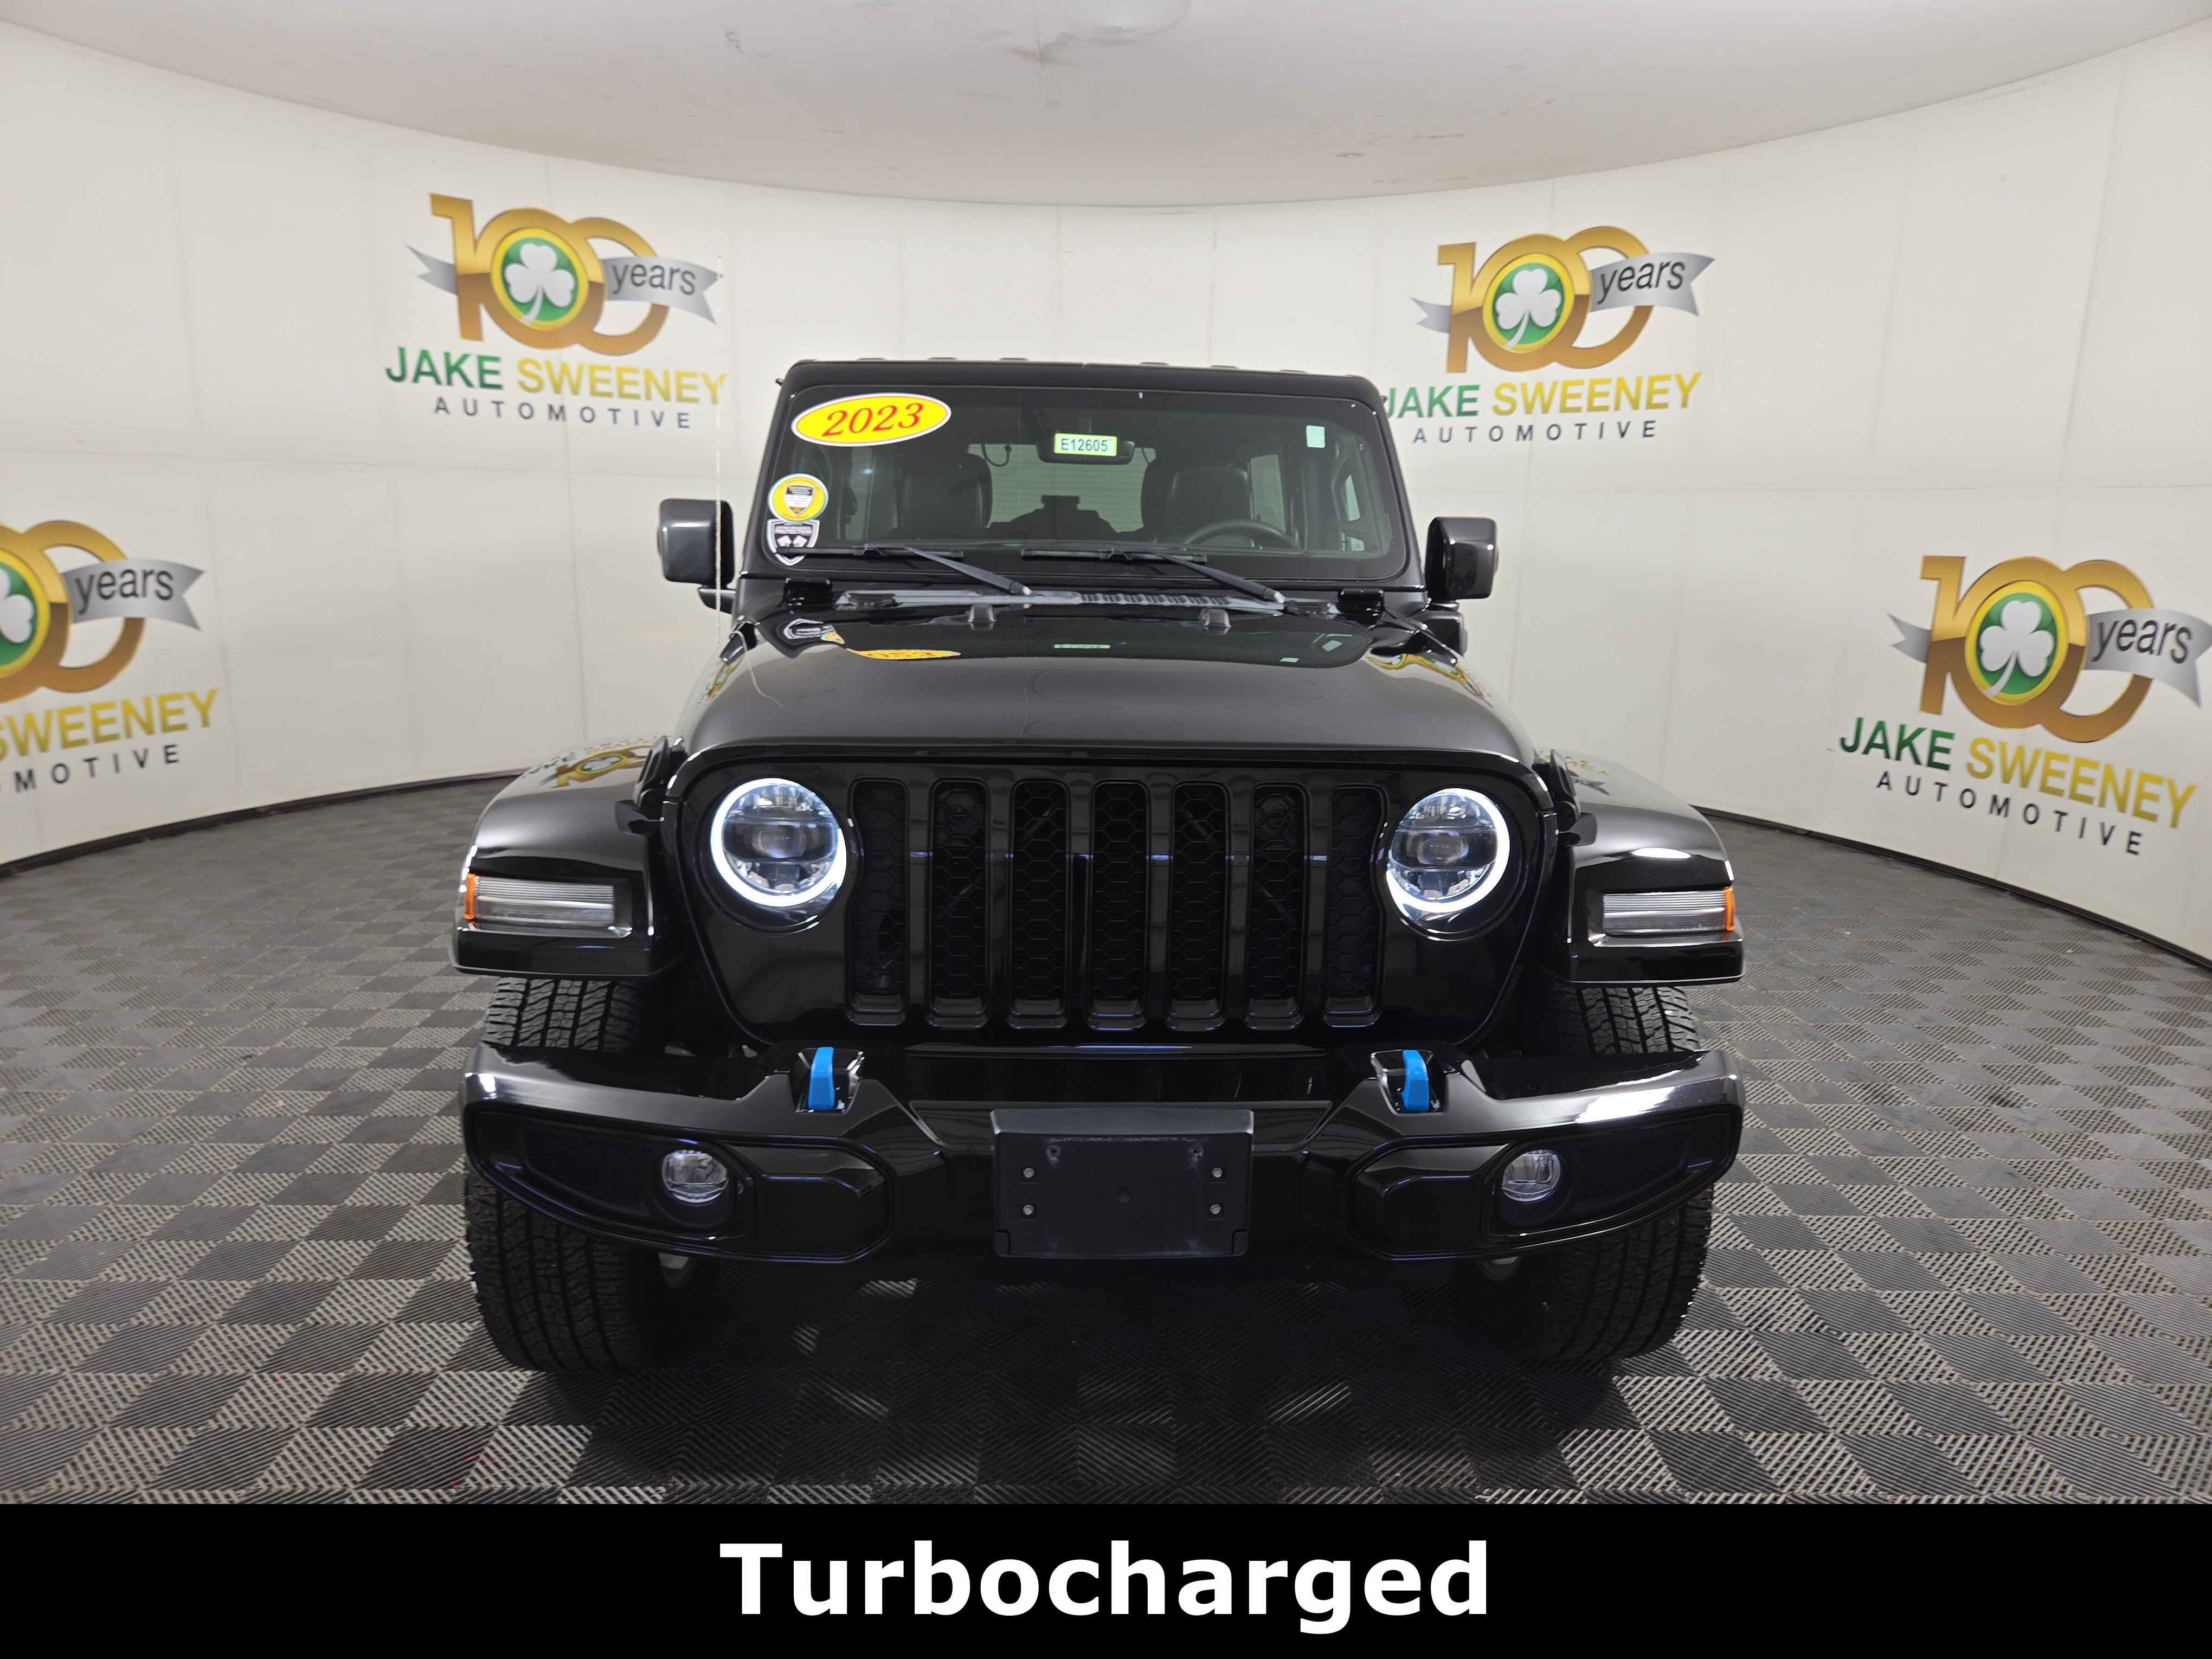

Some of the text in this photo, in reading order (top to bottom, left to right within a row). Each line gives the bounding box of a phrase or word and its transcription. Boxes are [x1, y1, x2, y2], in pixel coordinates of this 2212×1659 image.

[610, 263, 697, 295] years
[1597, 261, 1686, 305] years
[385, 346, 726, 404] JAKE SWEENEY
[1386, 372, 1702, 418] JAKE SWEENEY
[434, 396, 690, 428] AUTOMOTIVE
[821, 402, 924, 437] 2023
[1412, 420, 1656, 443] AUTOMOTIVE
[1061, 438, 1108, 452] E12605
[74, 568, 175, 615] years
[2091, 619, 2192, 664] years
[0, 689, 218, 759] WEENEY
[0, 744, 180, 794] MOTIVE
[1840, 717, 2198, 829] JAKE SWEENEY
[1875, 770, 2143, 856] AUTOMOTIVE
